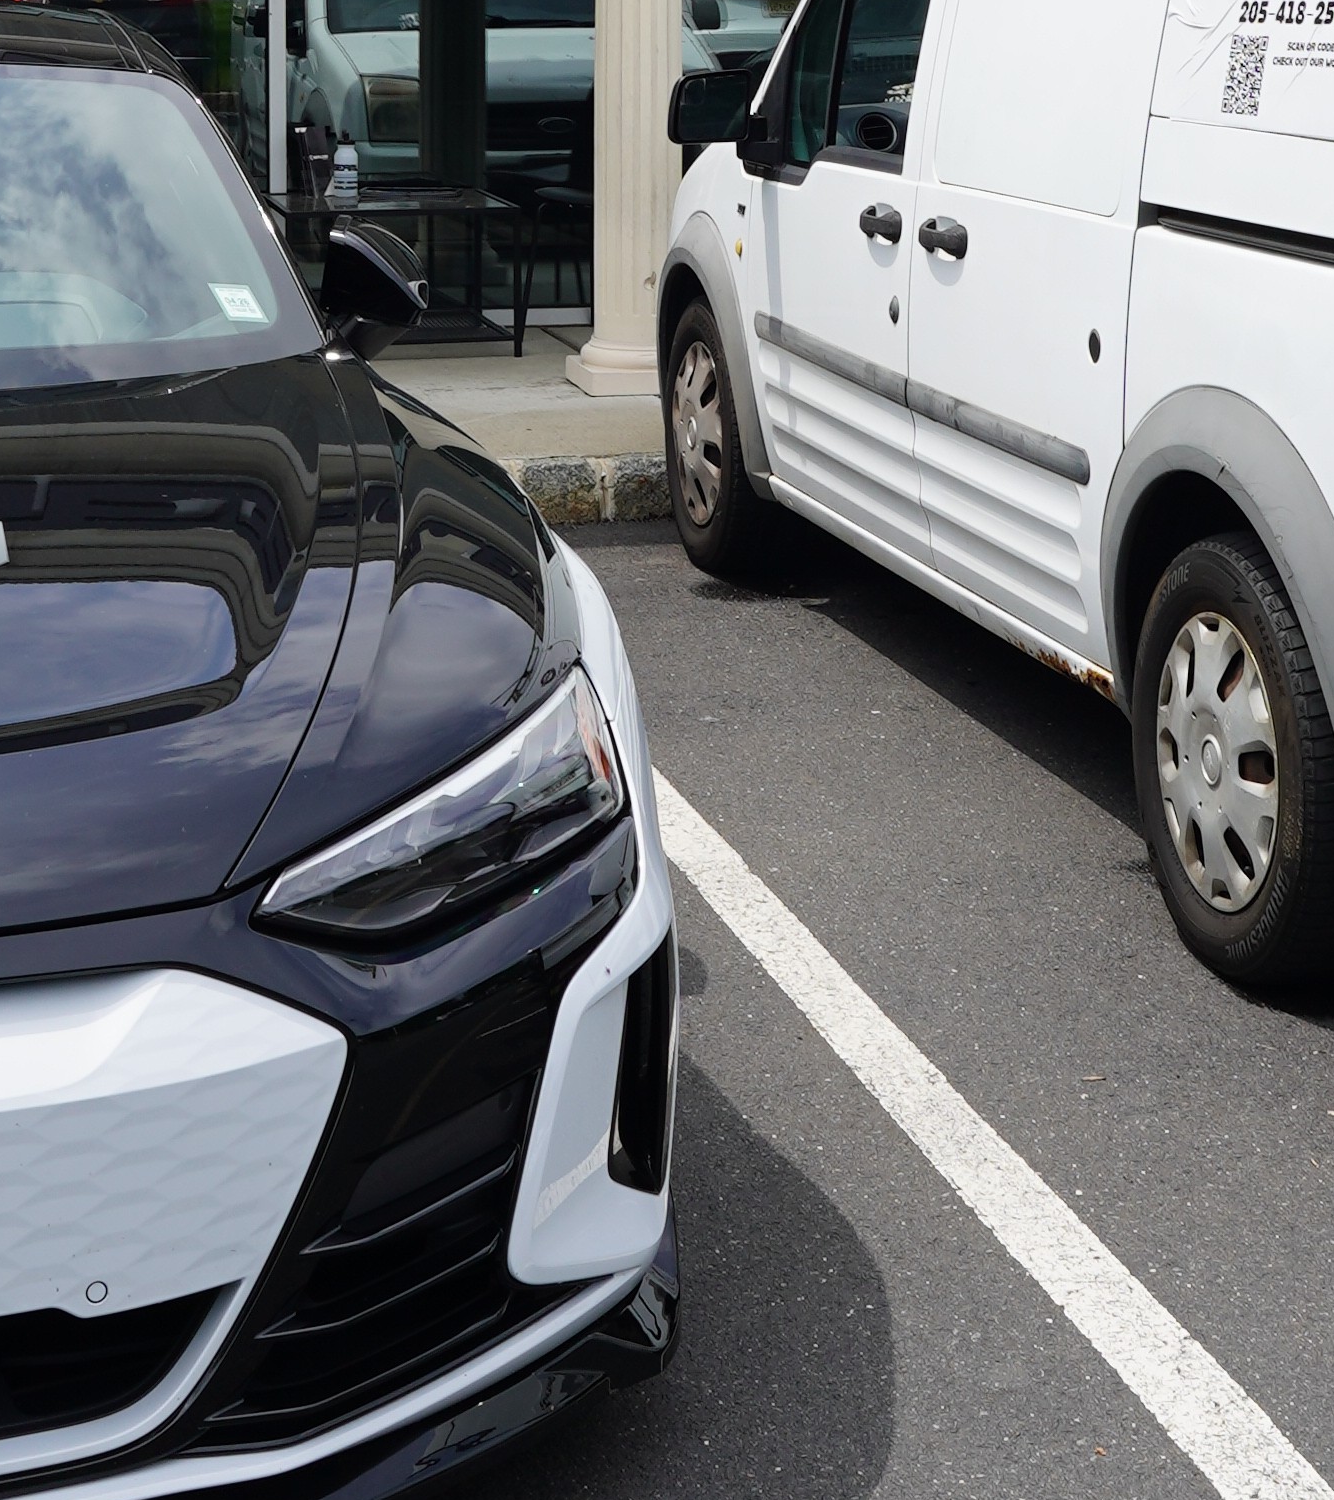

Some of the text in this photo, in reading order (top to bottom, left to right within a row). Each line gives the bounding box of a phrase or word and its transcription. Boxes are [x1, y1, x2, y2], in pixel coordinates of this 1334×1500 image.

[1287, 41, 1306, 52] SCAN
[1272, 56, 1293, 67] CHECK
[1294, 57, 1308, 67] OUT
[1309, 57, 1324, 68] OUR
[1225, 864, 1291, 961] BRIDGESTONE
